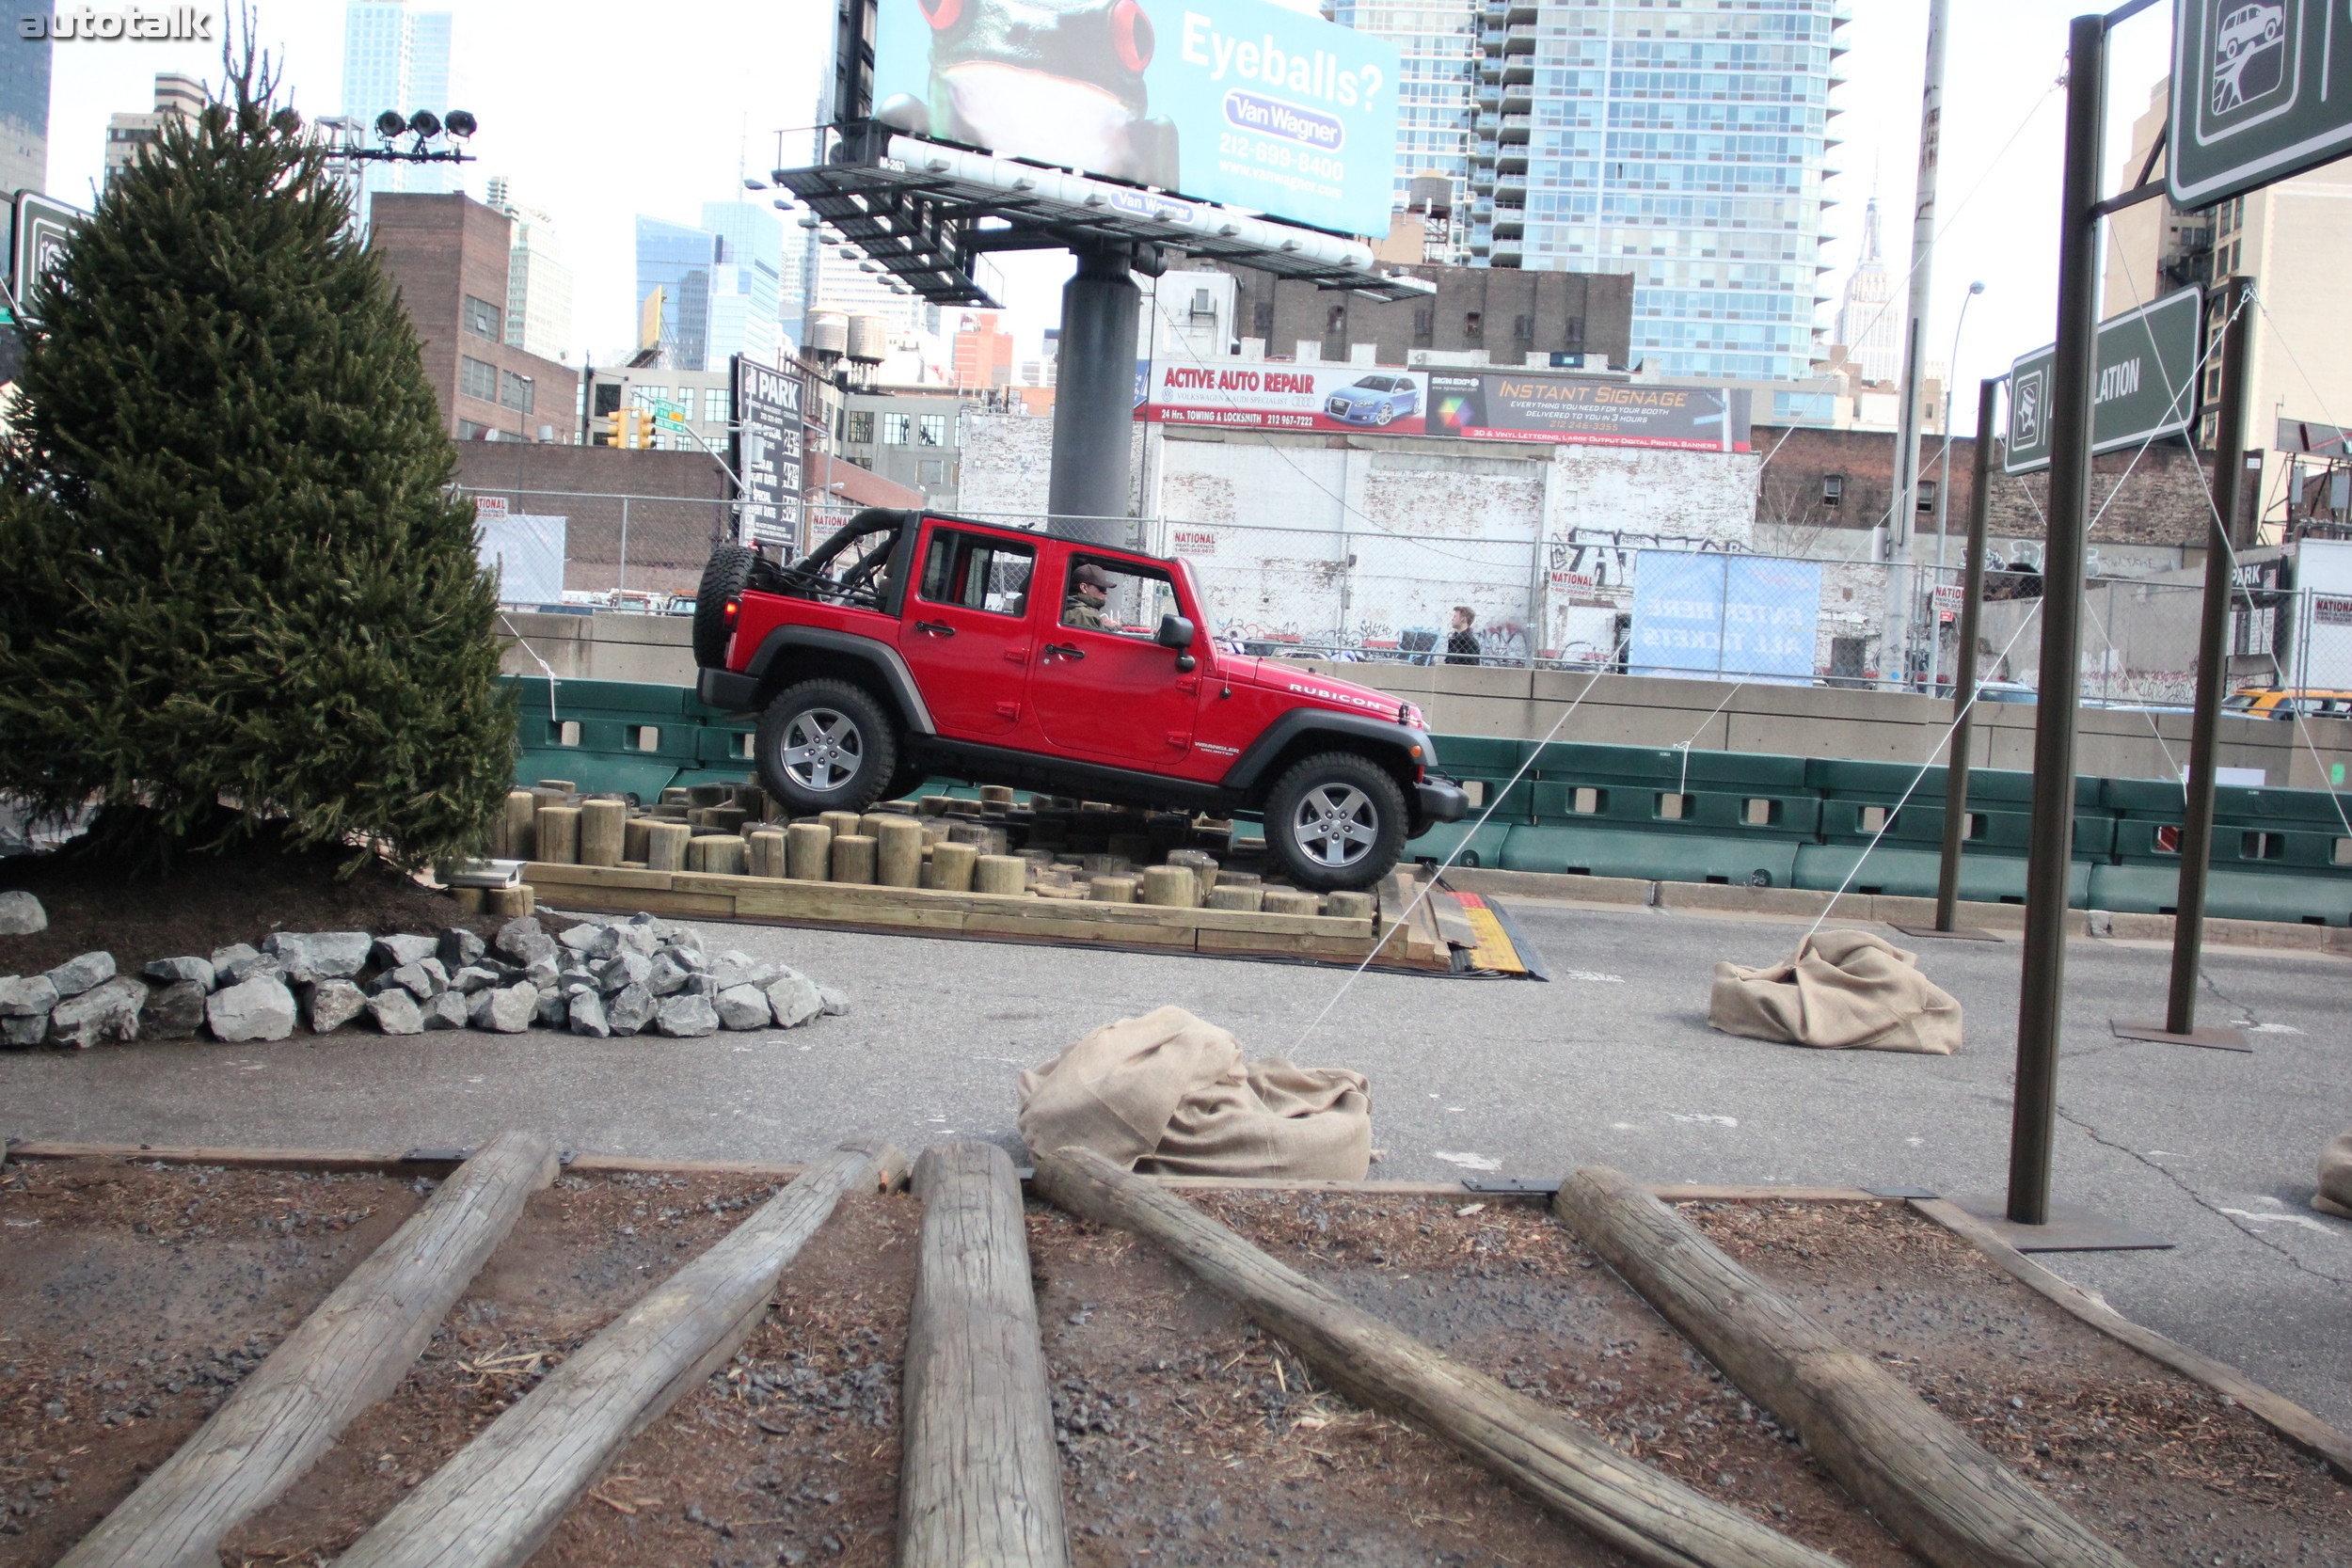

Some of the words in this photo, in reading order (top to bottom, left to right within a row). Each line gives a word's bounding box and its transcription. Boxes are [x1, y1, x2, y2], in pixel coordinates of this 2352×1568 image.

[1182, 9, 1384, 112] Eyeballs?
[1230, 95, 1268, 125] Van
[1270, 105, 1338, 143] Wagner
[880, 155, 905, 172] M-263
[1219, 133, 1343, 182] 212-699-8400
[1219, 159, 1343, 198] www.vanwagner.com
[1117, 191, 1142, 209] Van
[1164, 367, 1215, 389] ACTIVE
[1218, 370, 1260, 392] AUTO
[1263, 372, 1314, 394] REPAIR
[759, 371, 799, 411] PARK
[1177, 392, 1223, 402] VOLKSWAGEN
[1511, 401, 1560, 410] EVERYTHING
[1579, 404, 1600, 412] NEED
[1618, 406, 1640, 415] YOUR
[1642, 408, 1669, 417] BOOTH
[1526, 410, 1570, 420] DELIVERED
[1611, 413, 1619, 421] 3
[1620, 415, 1648, 423] HOURS
[1161, 409, 1169, 420] 24
[1172, 410, 1184, 420] Hrs.
[1187, 410, 1215, 421] TOWING
[1216, 412, 1222, 421] &
[1223, 412, 1262, 423] LOCKSMITH
[1267, 414, 1279, 424] 212
[1281, 415, 1313, 426] 967-7222
[1549, 420, 1565, 429] 212
[1473, 429, 1486, 437] 3D
[474, 498, 505, 509] TIONAL
[813, 515, 849, 527] NATIONA
[1175, 532, 1216, 544] NATIONAL
[1551, 571, 1594, 586] NATIONAL
[2233, 564, 2262, 586] PARK
[1935, 585, 1965, 599] NATION
[2316, 600, 2352, 612] NATIONA
[1289, 683, 1380, 709] RUBICON
[1194, 741, 1240, 753] WRANGLER
